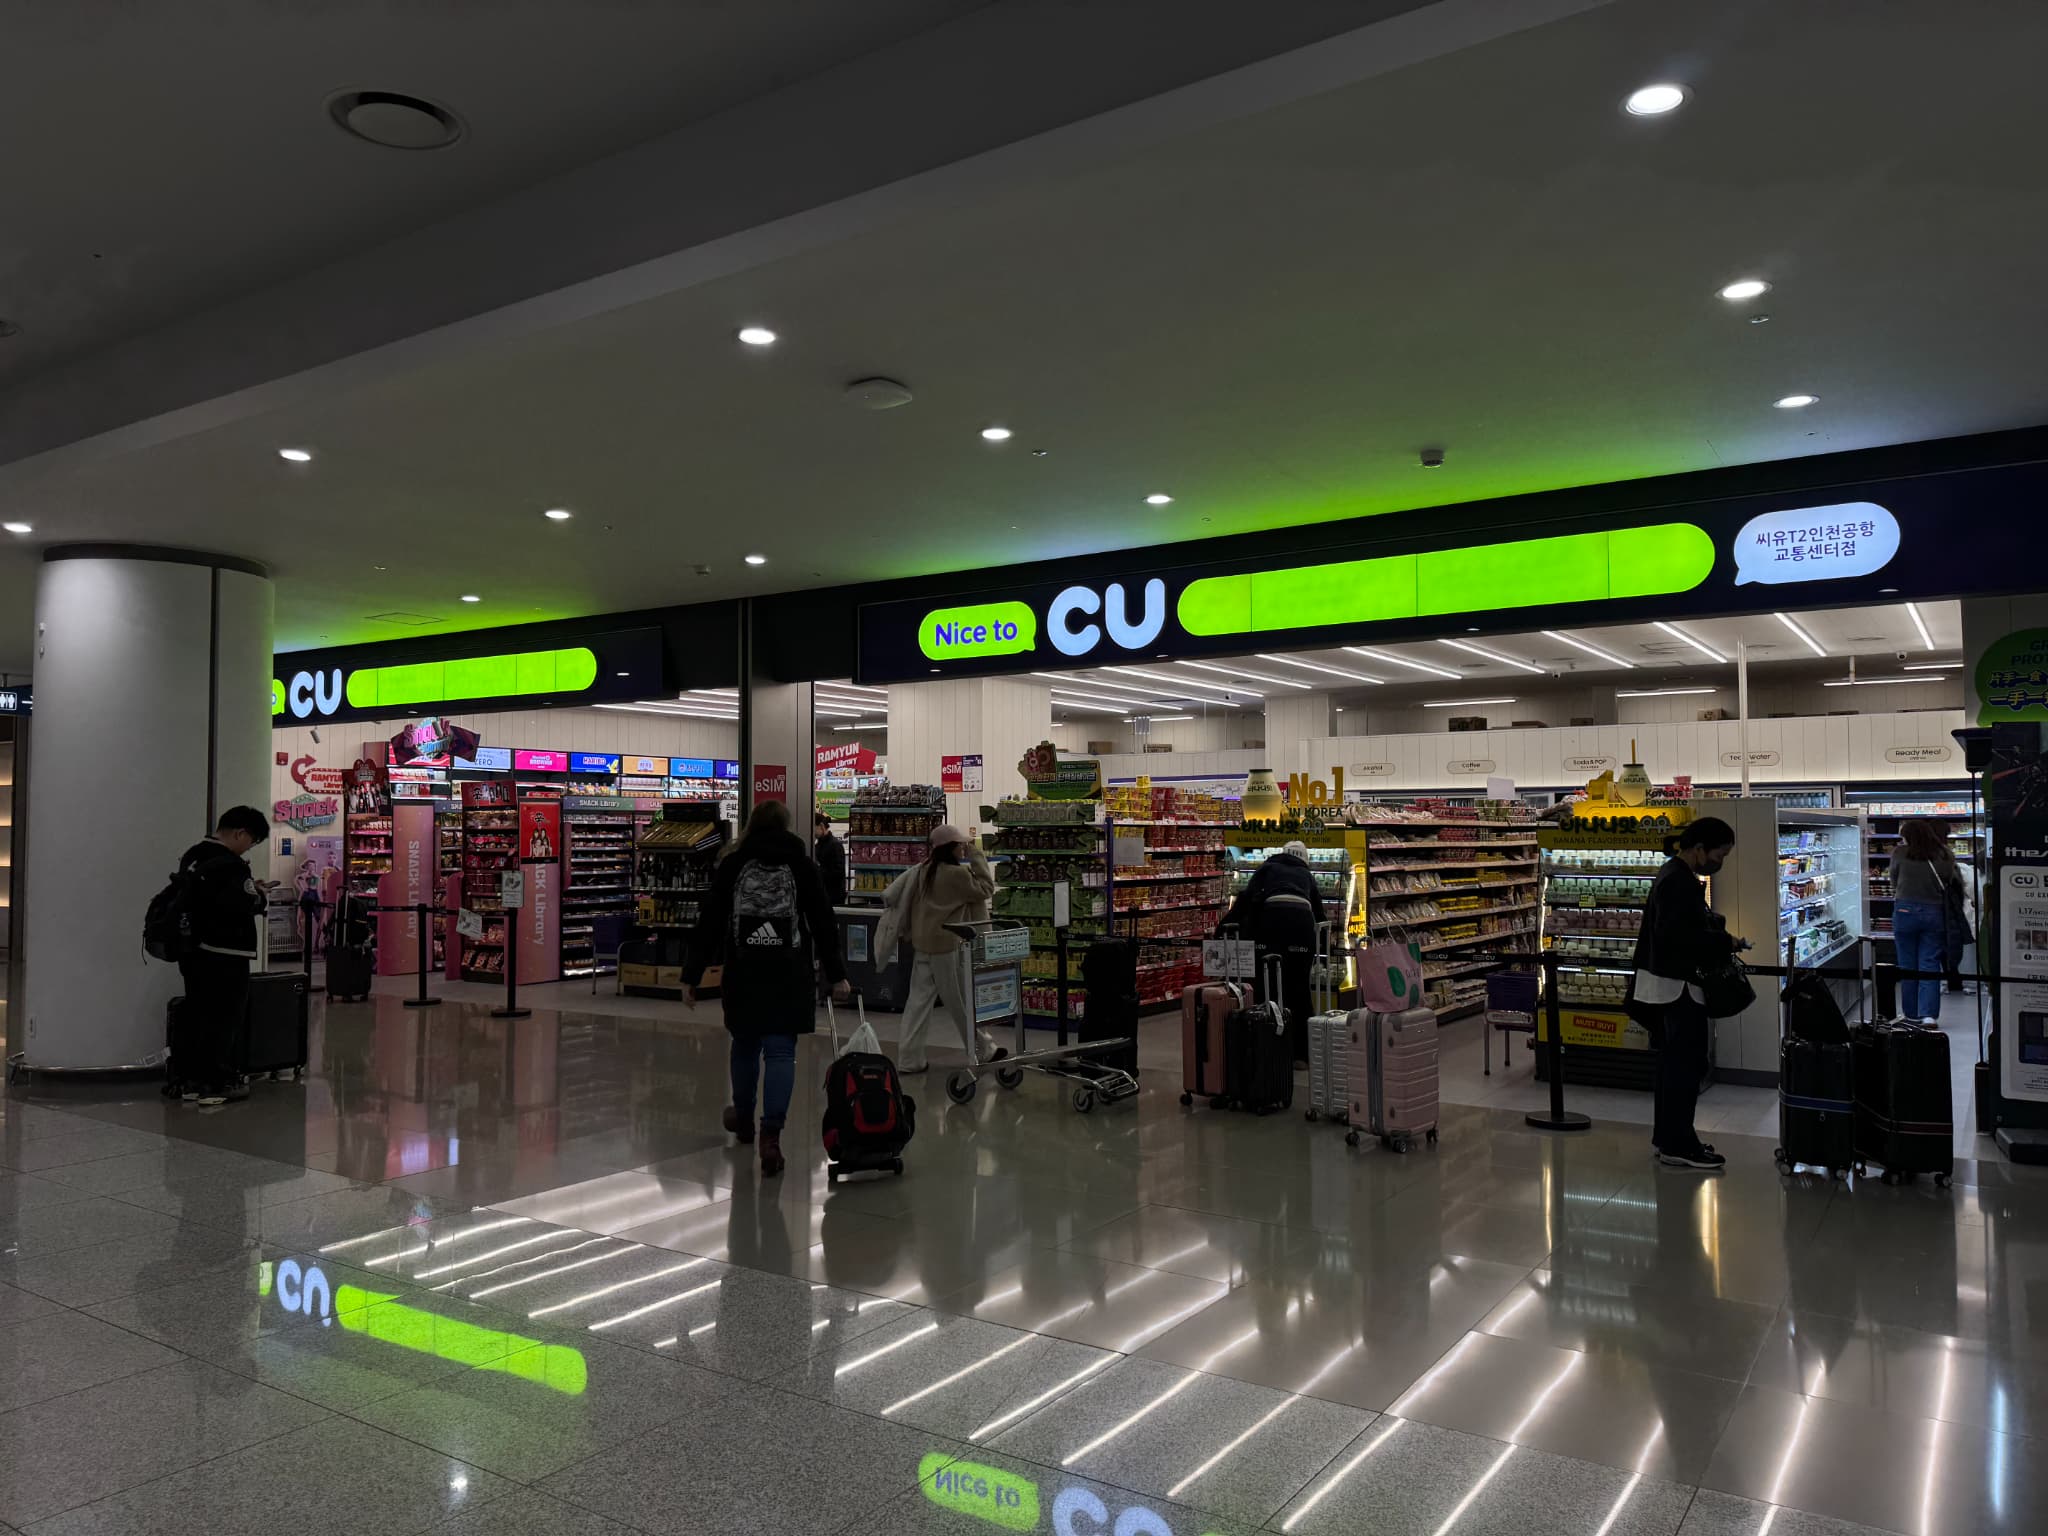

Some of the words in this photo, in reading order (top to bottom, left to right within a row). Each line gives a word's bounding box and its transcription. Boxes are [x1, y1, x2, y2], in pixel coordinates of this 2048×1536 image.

[1755, 521, 1876, 547] 씨유T2인천공항
[1774, 540, 1856, 561] 교통센터점
[935, 622, 982, 647] Nice
[992, 619, 1018, 642] to
[1046, 577, 1166, 656] CU
[289, 668, 342, 719] CU
[817, 742, 860, 764] RAMYUN
[1895, 750, 1920, 759] Ready
[1922, 749, 1941, 757] Meal
[942, 764, 962, 775] eSIM
[755, 778, 785, 792] eSIM
[1290, 767, 1344, 807] No.1
[1645, 789, 1684, 798] Korea's
[275, 797, 339, 822] Snack
[1289, 807, 1301, 818] IN
[1303, 807, 1344, 818] KOREA
[1645, 798, 1689, 807] Favorite
[408, 841, 421, 887] SNACK
[2015, 876, 2034, 885] CU
[532, 893, 546, 946] Library
[746, 936, 784, 946] adidas
